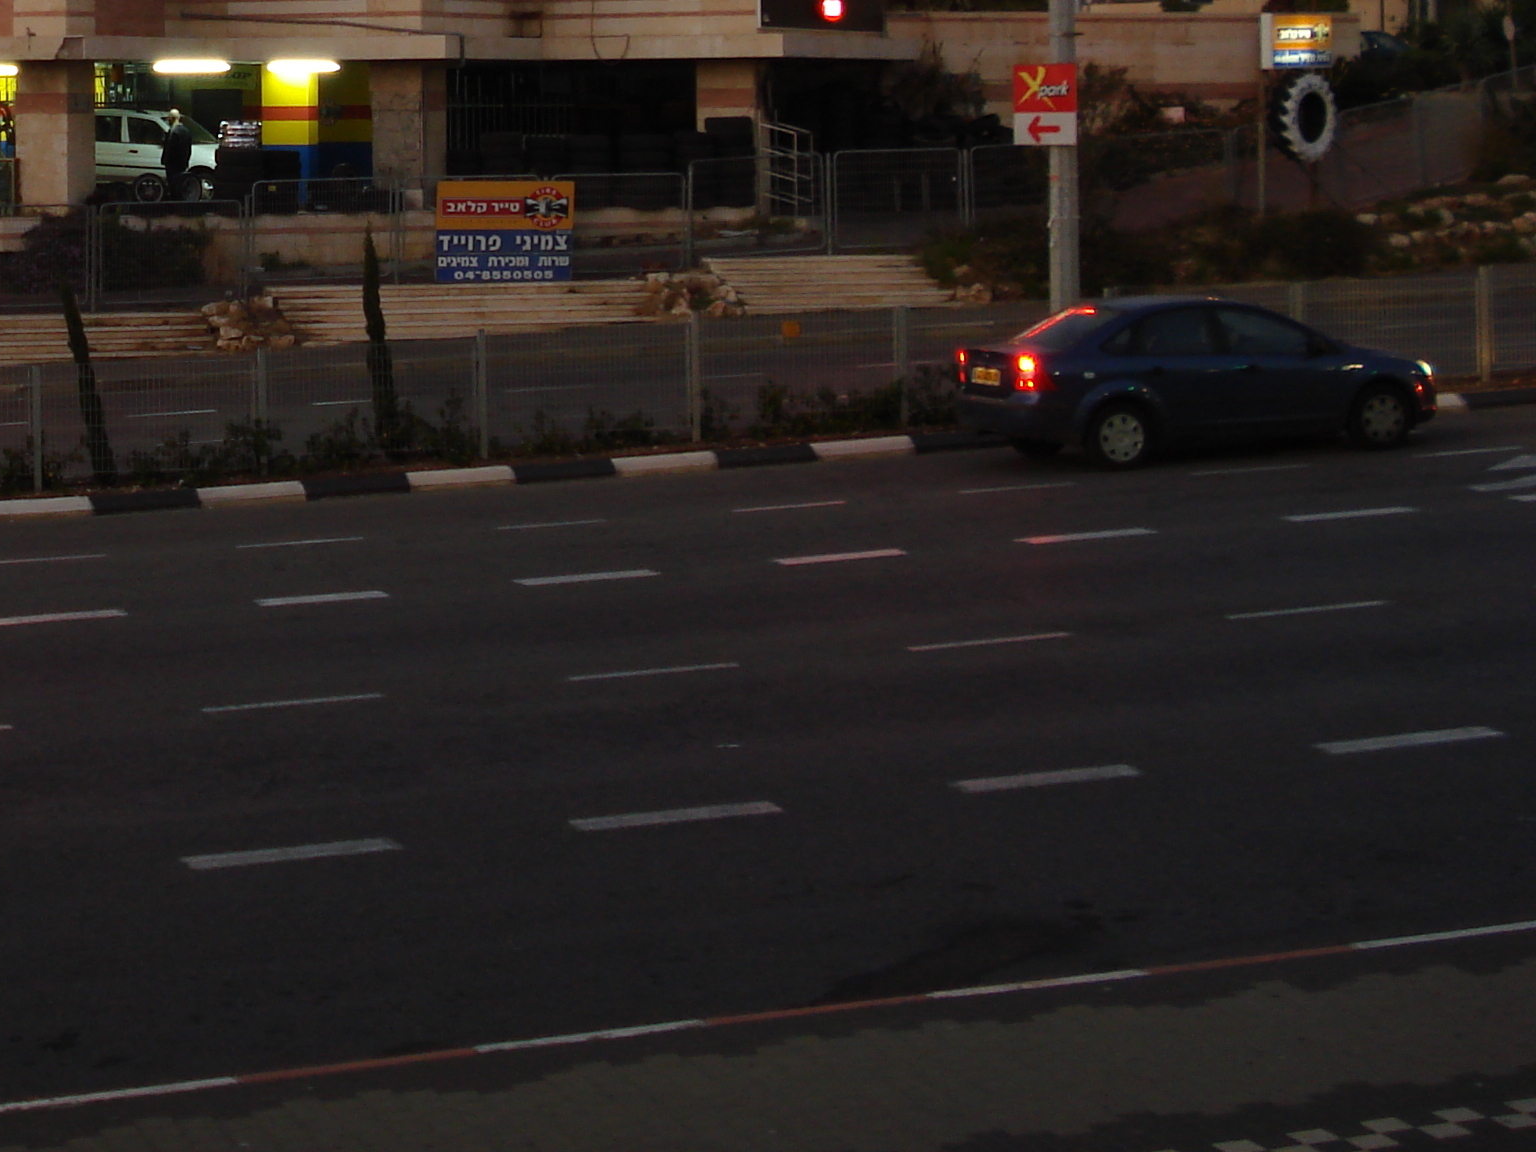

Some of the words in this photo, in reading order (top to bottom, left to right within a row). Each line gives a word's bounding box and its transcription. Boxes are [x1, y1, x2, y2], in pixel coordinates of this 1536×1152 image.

[446, 201, 487, 214] קלאב
[491, 202, 521, 213] טייר
[438, 234, 502, 252] פרוייד
[516, 234, 568, 251] צמיגי
[437, 256, 479, 268] צמיגים
[488, 256, 530, 268] ומכירת
[538, 255, 570, 267] שרות
[453, 270, 554, 281] 04-8550505
